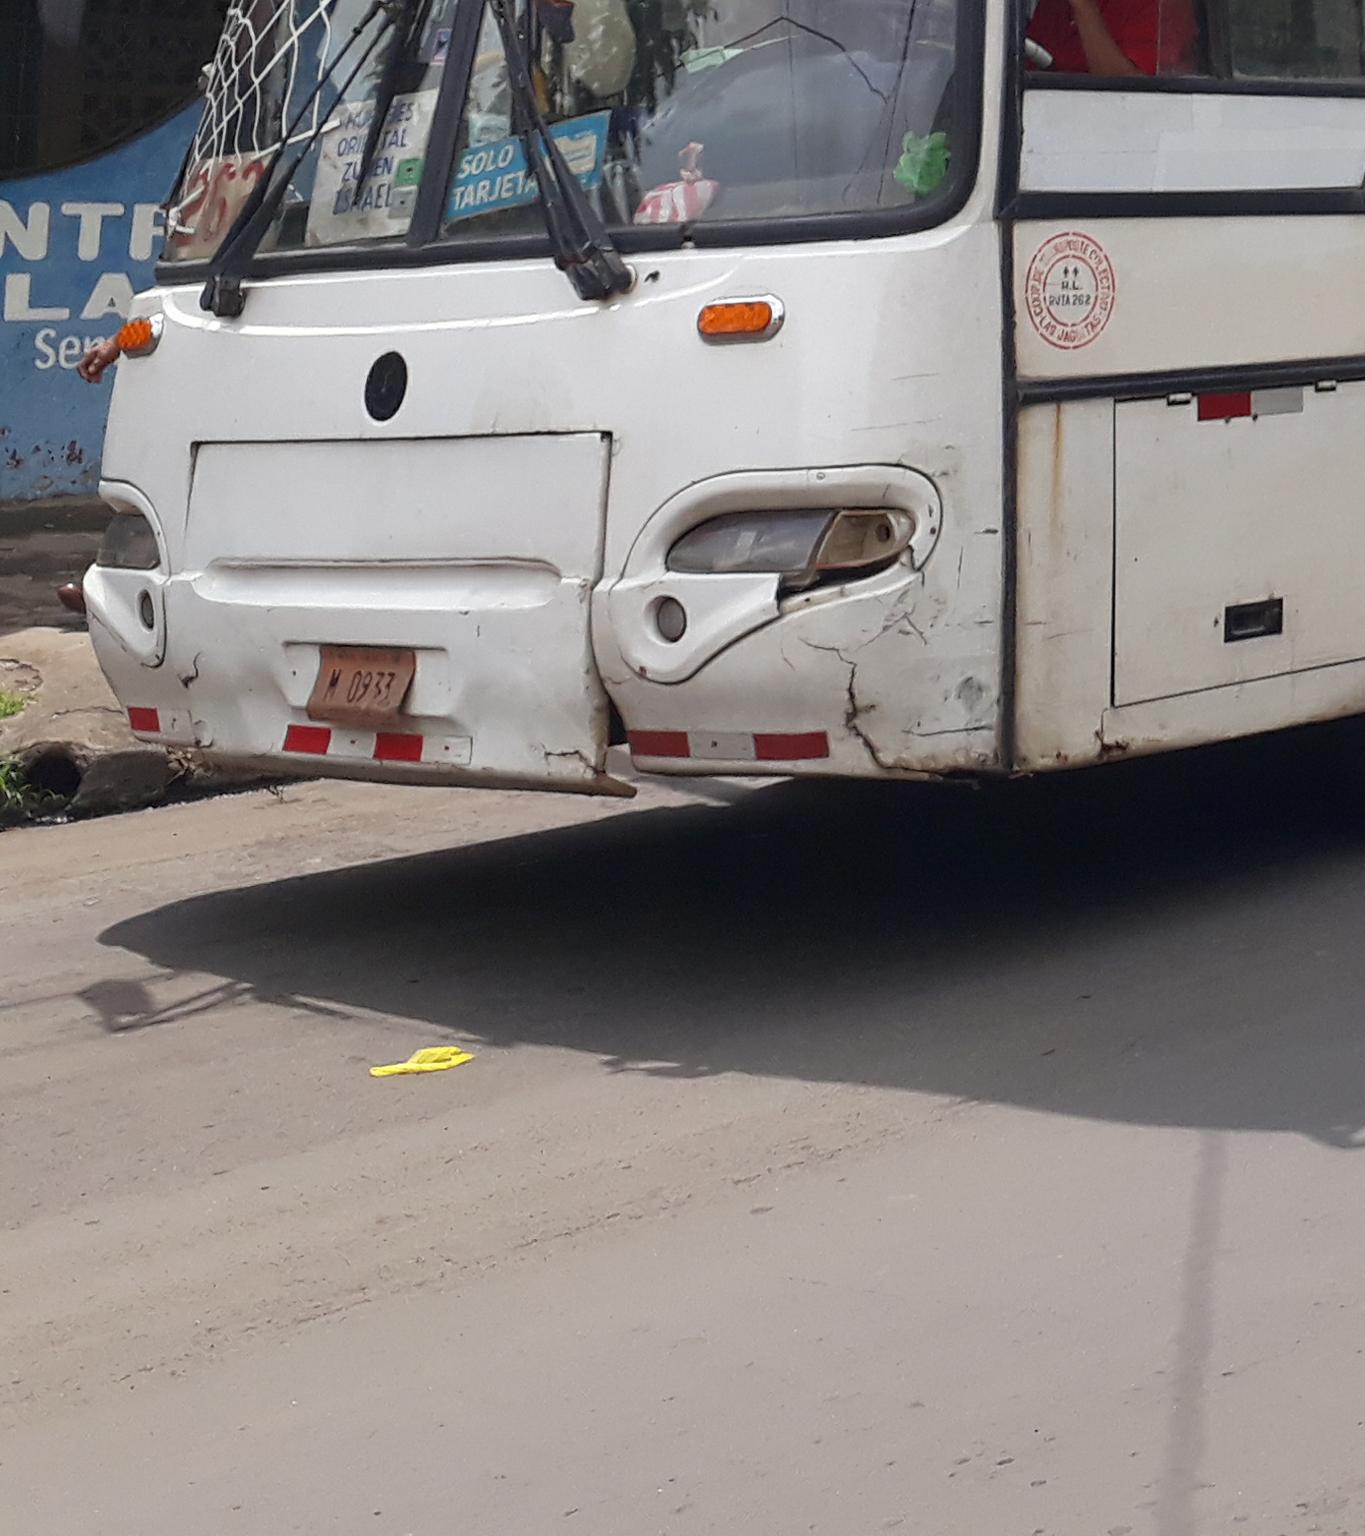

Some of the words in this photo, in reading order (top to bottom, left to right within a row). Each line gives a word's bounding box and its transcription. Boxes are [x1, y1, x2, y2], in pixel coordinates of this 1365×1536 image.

[337, 128, 408, 158] ORITAL
[341, 155, 394, 183] ZUEN
[458, 144, 514, 179] SOLO
[451, 169, 539, 211] TARJETA
[1072, 294, 1092, 306] 262
